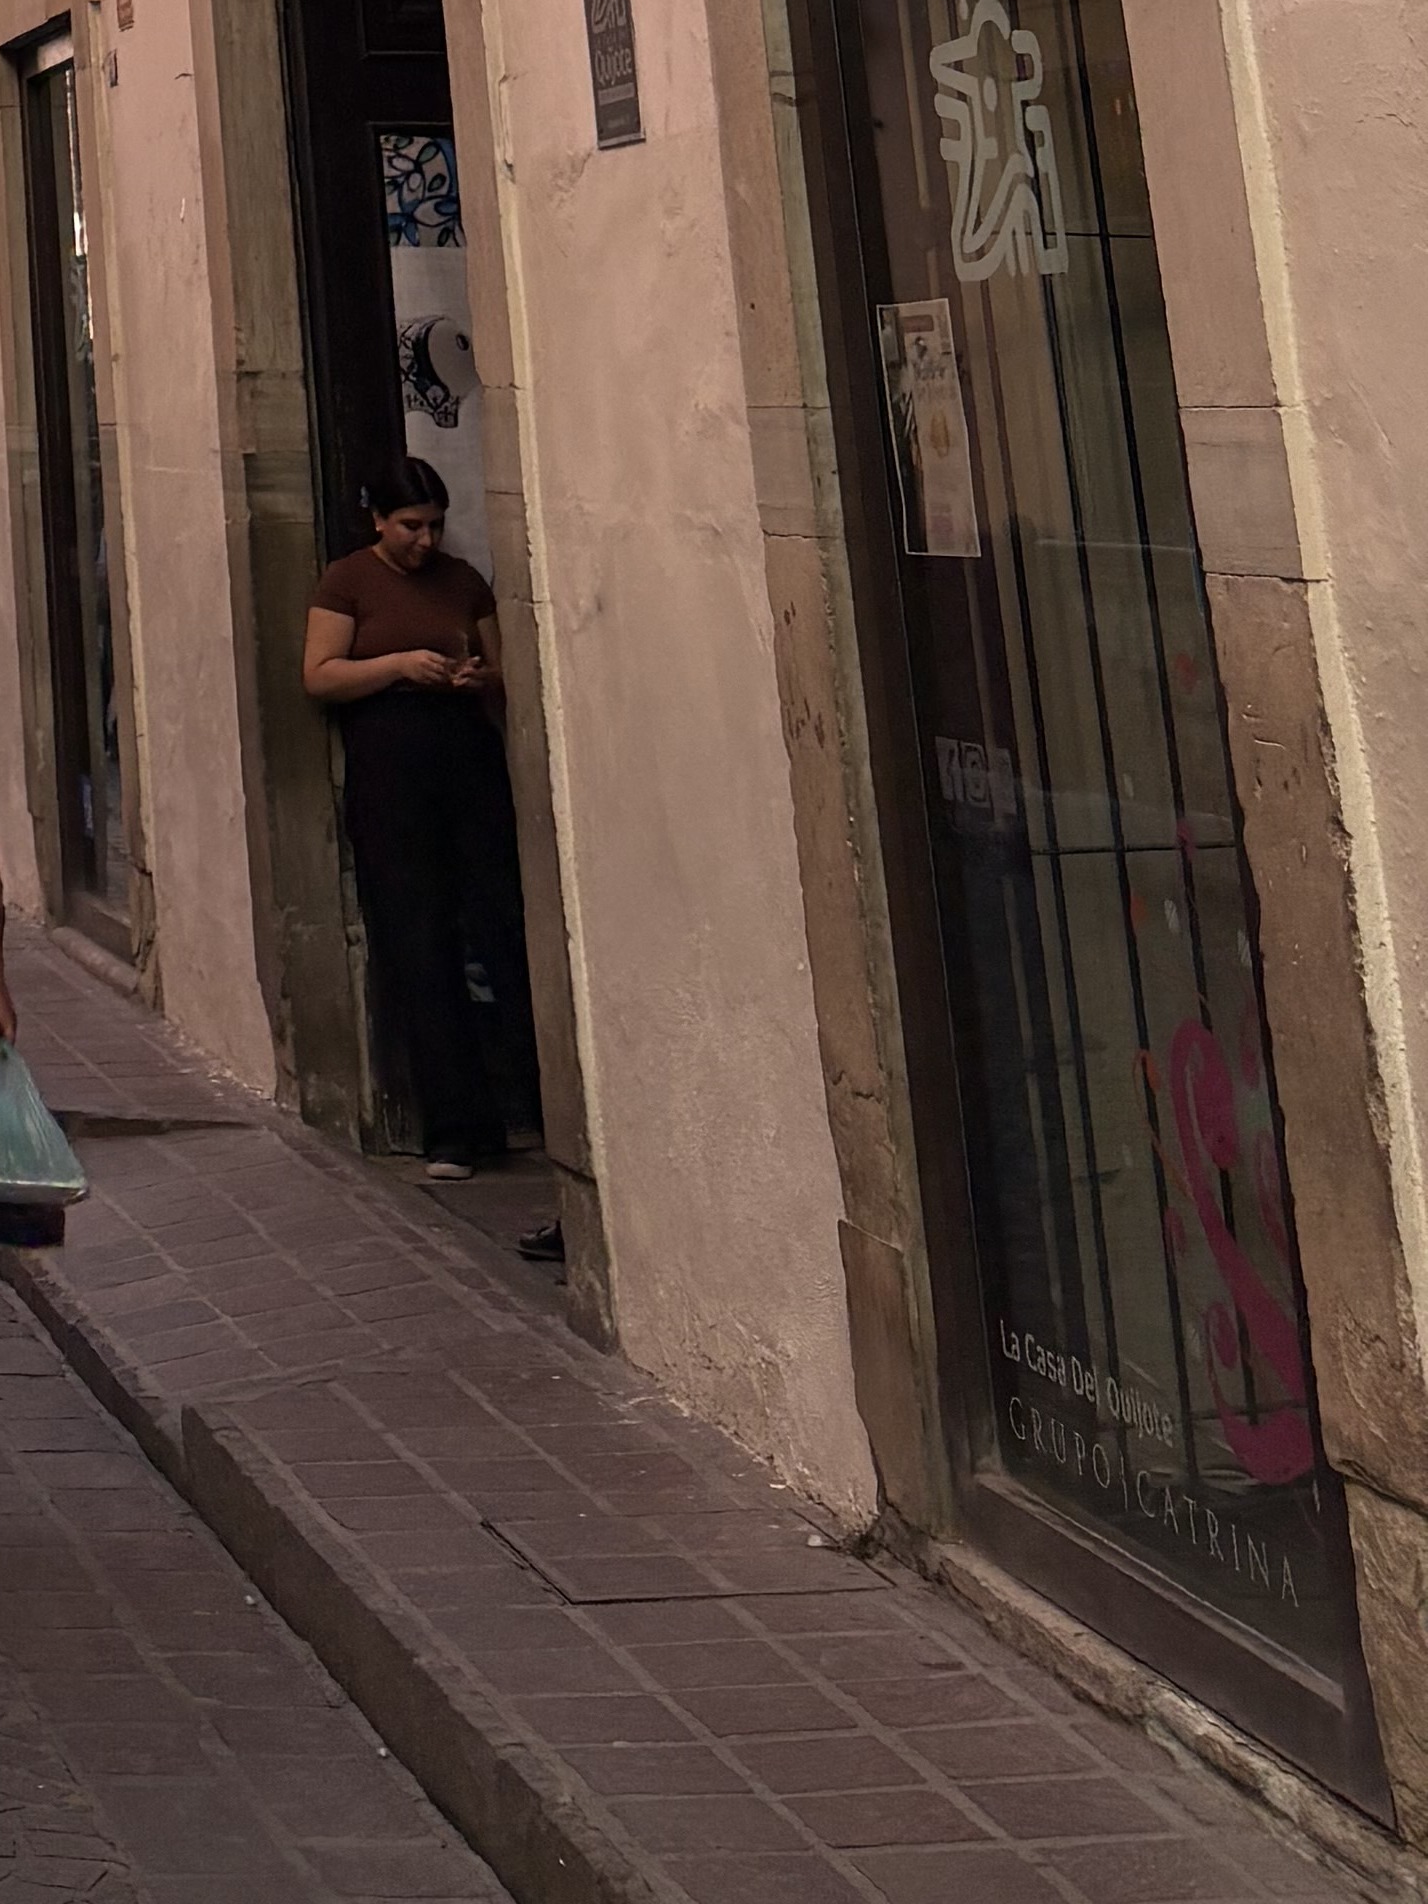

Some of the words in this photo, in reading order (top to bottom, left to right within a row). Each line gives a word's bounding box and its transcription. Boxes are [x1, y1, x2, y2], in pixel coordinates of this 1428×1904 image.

[1000, 1319, 1021, 1362] La
[1025, 1333, 1067, 1387] Casa
[1071, 1355, 1100, 1404] Del
[1106, 1376, 1174, 1448] Quijote
[1008, 1396, 1111, 1489] GRUPO
[1135, 1470, 1300, 1609] CATRINA
